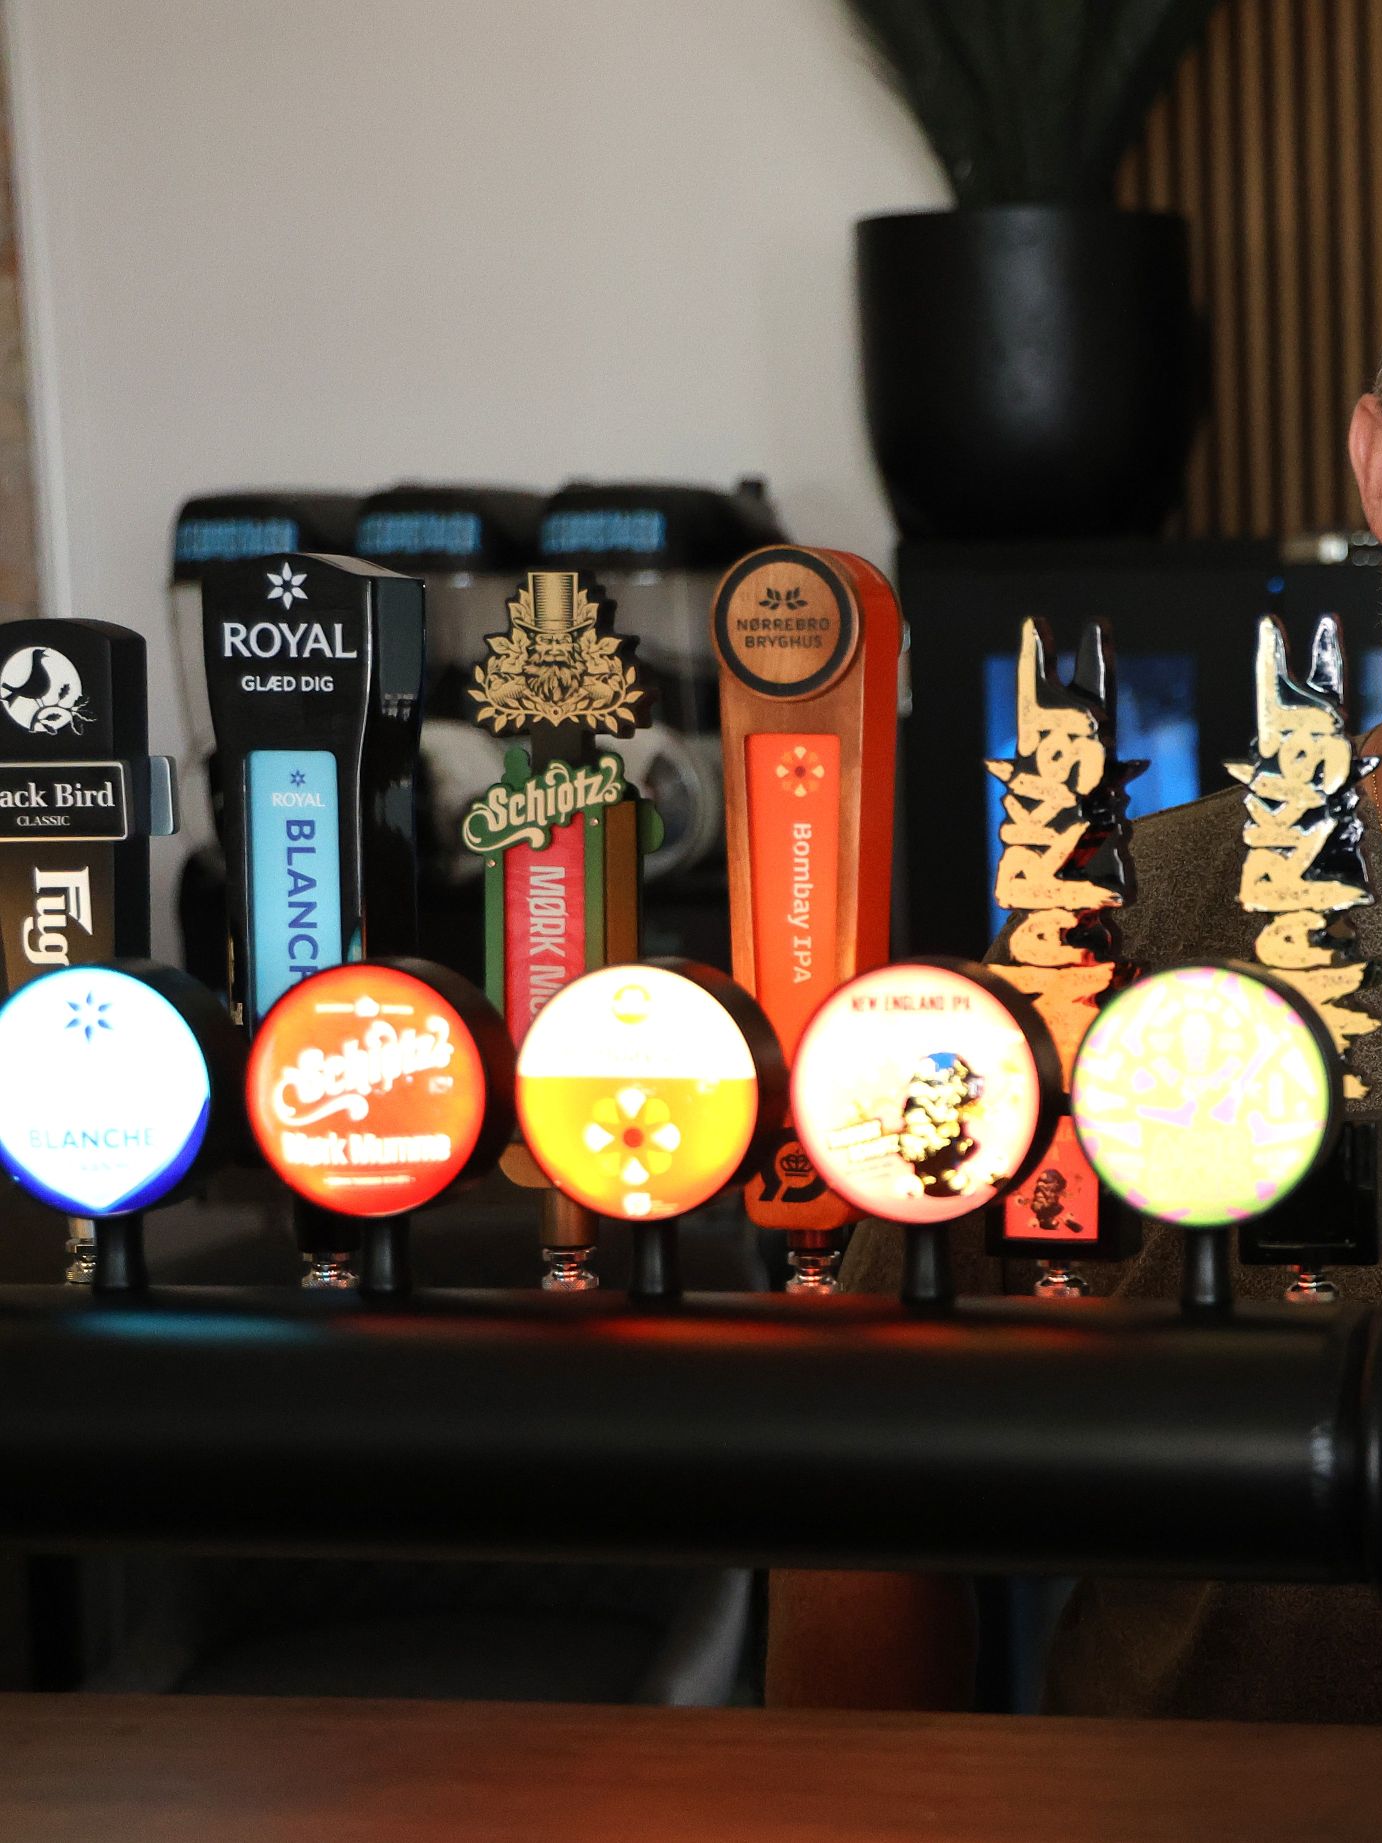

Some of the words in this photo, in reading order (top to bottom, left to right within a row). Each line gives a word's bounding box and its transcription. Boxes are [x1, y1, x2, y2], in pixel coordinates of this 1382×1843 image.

[736, 617, 830, 631] NØRREBRO
[223, 622, 357, 658] ROYAL
[744, 635, 822, 649] BRYGHUS
[241, 675, 296, 692] GLÆD
[301, 676, 334, 692] DIG
[54, 781, 116, 807] Bird
[272, 792, 325, 808] ROYAL
[16, 815, 71, 826] CLASSIC
[787, 823, 813, 929] Bombay
[526, 866, 569, 957] MØRK
[793, 935, 812, 983] IPA
[28, 1127, 159, 1149] BLANCHE
